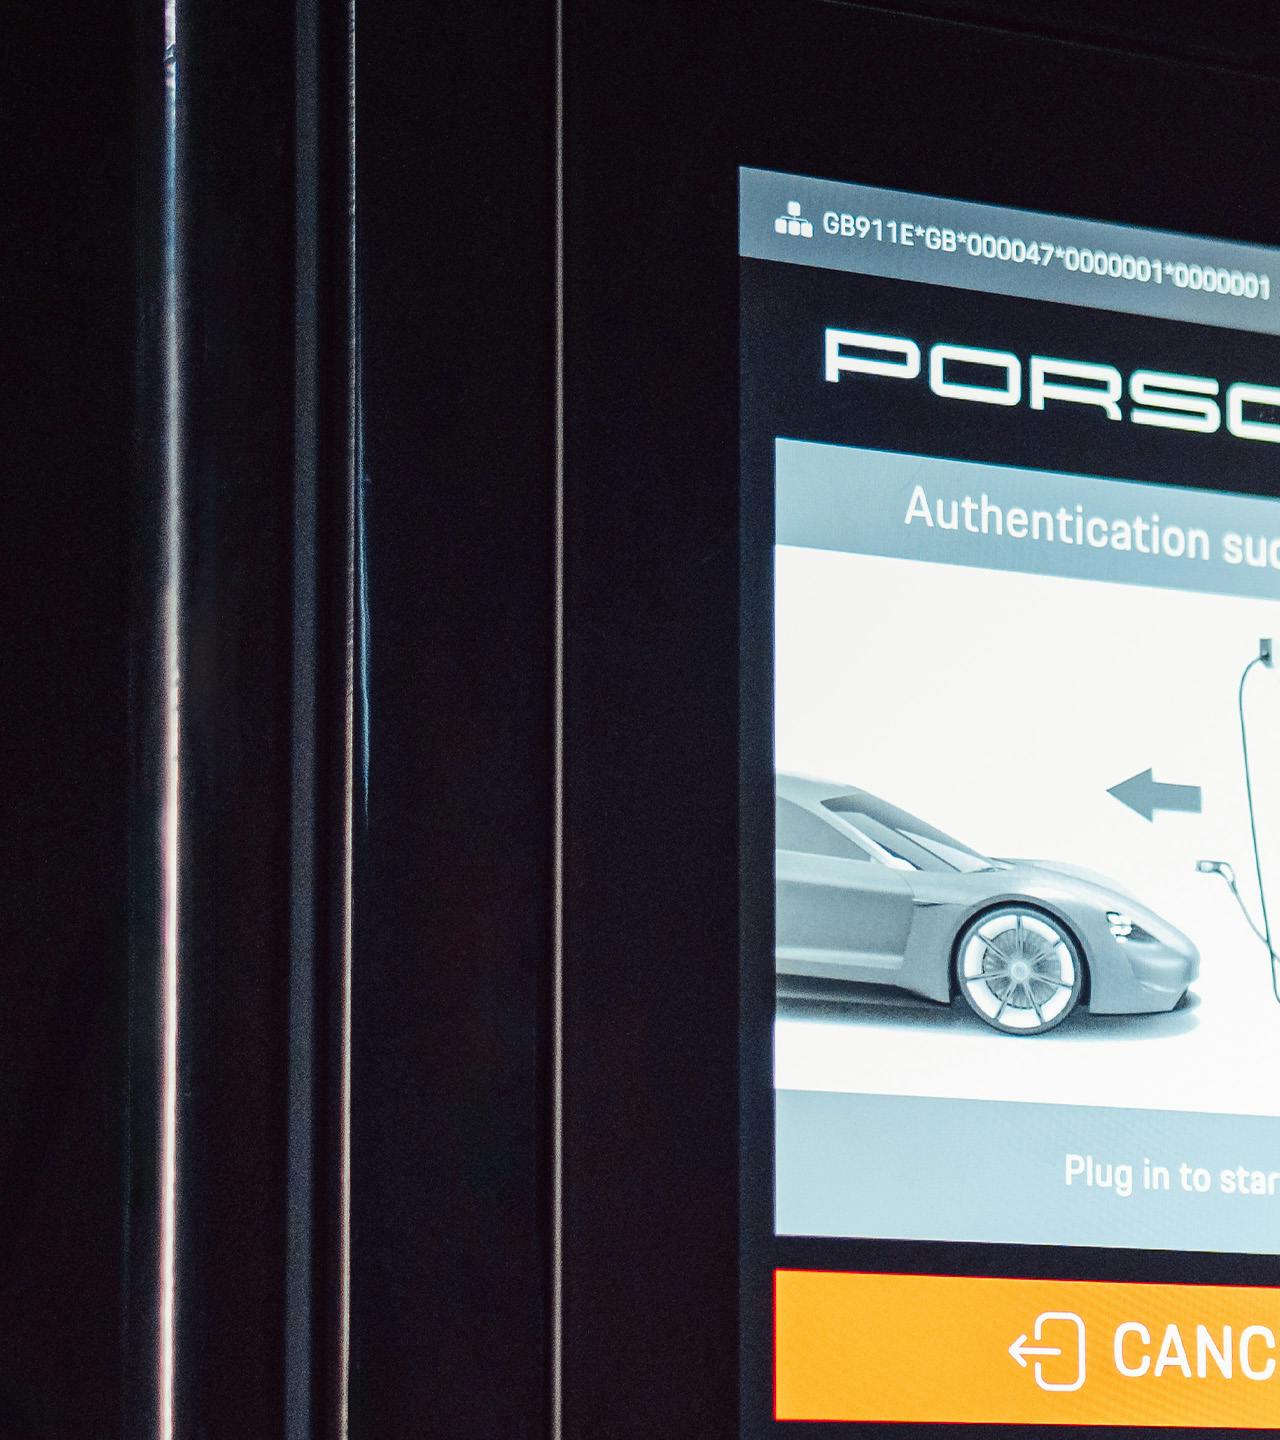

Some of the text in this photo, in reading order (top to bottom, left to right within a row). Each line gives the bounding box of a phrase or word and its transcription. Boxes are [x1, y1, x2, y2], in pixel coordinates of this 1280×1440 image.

[903, 483, 1210, 560] Authentication
[1063, 1154, 1133, 1198] Plug
[1142, 1157, 1171, 1192] in
[1179, 1162, 1212, 1194] to
